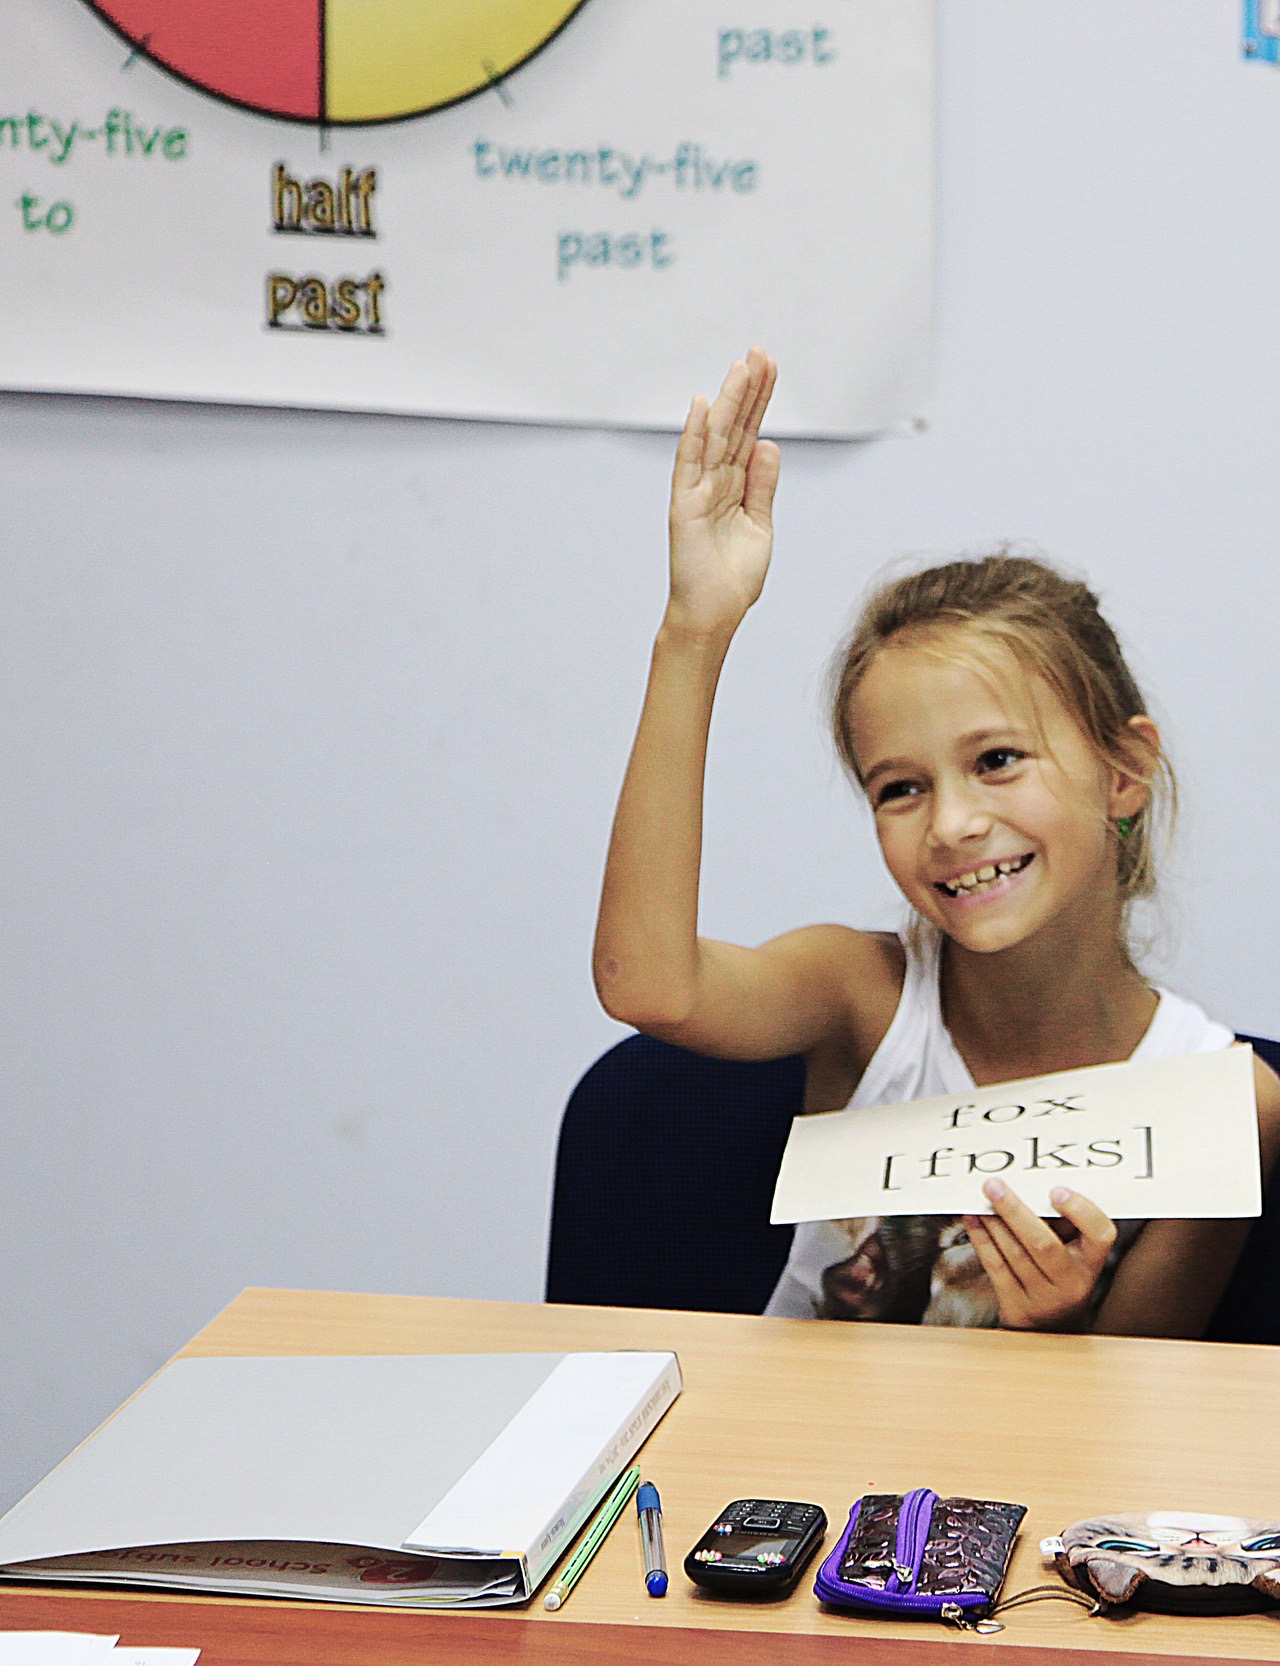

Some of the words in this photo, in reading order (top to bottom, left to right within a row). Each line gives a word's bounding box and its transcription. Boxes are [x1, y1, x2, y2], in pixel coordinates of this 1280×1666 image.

[717, 24, 836, 80] past
[473, 141, 759, 199] twenty-five
[16, 191, 75, 235] to
[271, 163, 377, 238] half
[557, 228, 675, 283] past
[266, 273, 386, 336] past
[943, 1094, 1086, 1131] fox
[208, 1556, 331, 1574] School
